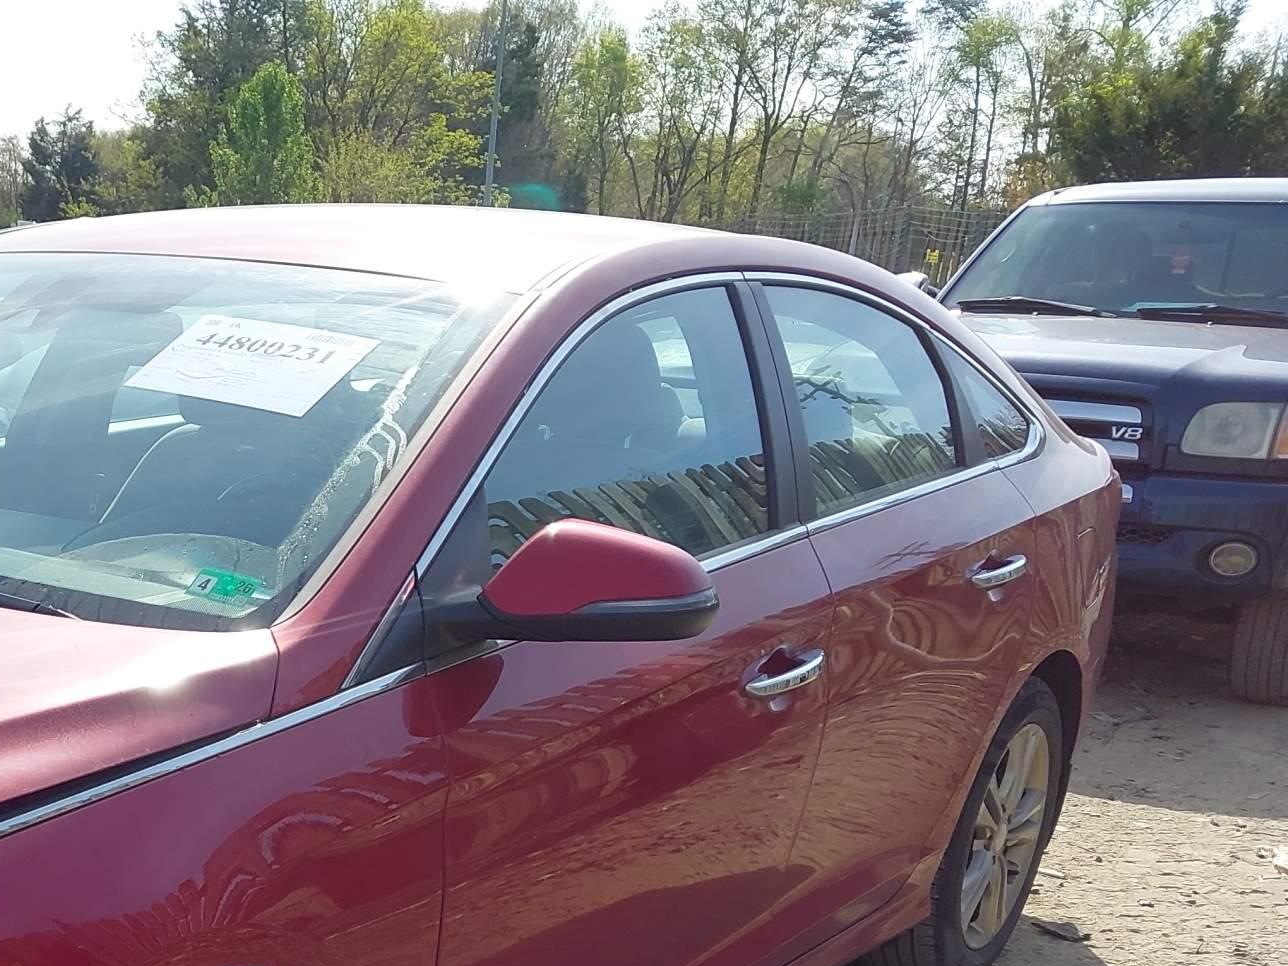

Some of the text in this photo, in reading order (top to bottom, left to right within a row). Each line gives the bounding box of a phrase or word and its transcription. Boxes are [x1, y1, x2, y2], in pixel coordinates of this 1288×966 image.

[195, 331, 337, 365] 44800231
[1111, 426, 1143, 440] V8
[197, 578, 255, 594] 4 26
